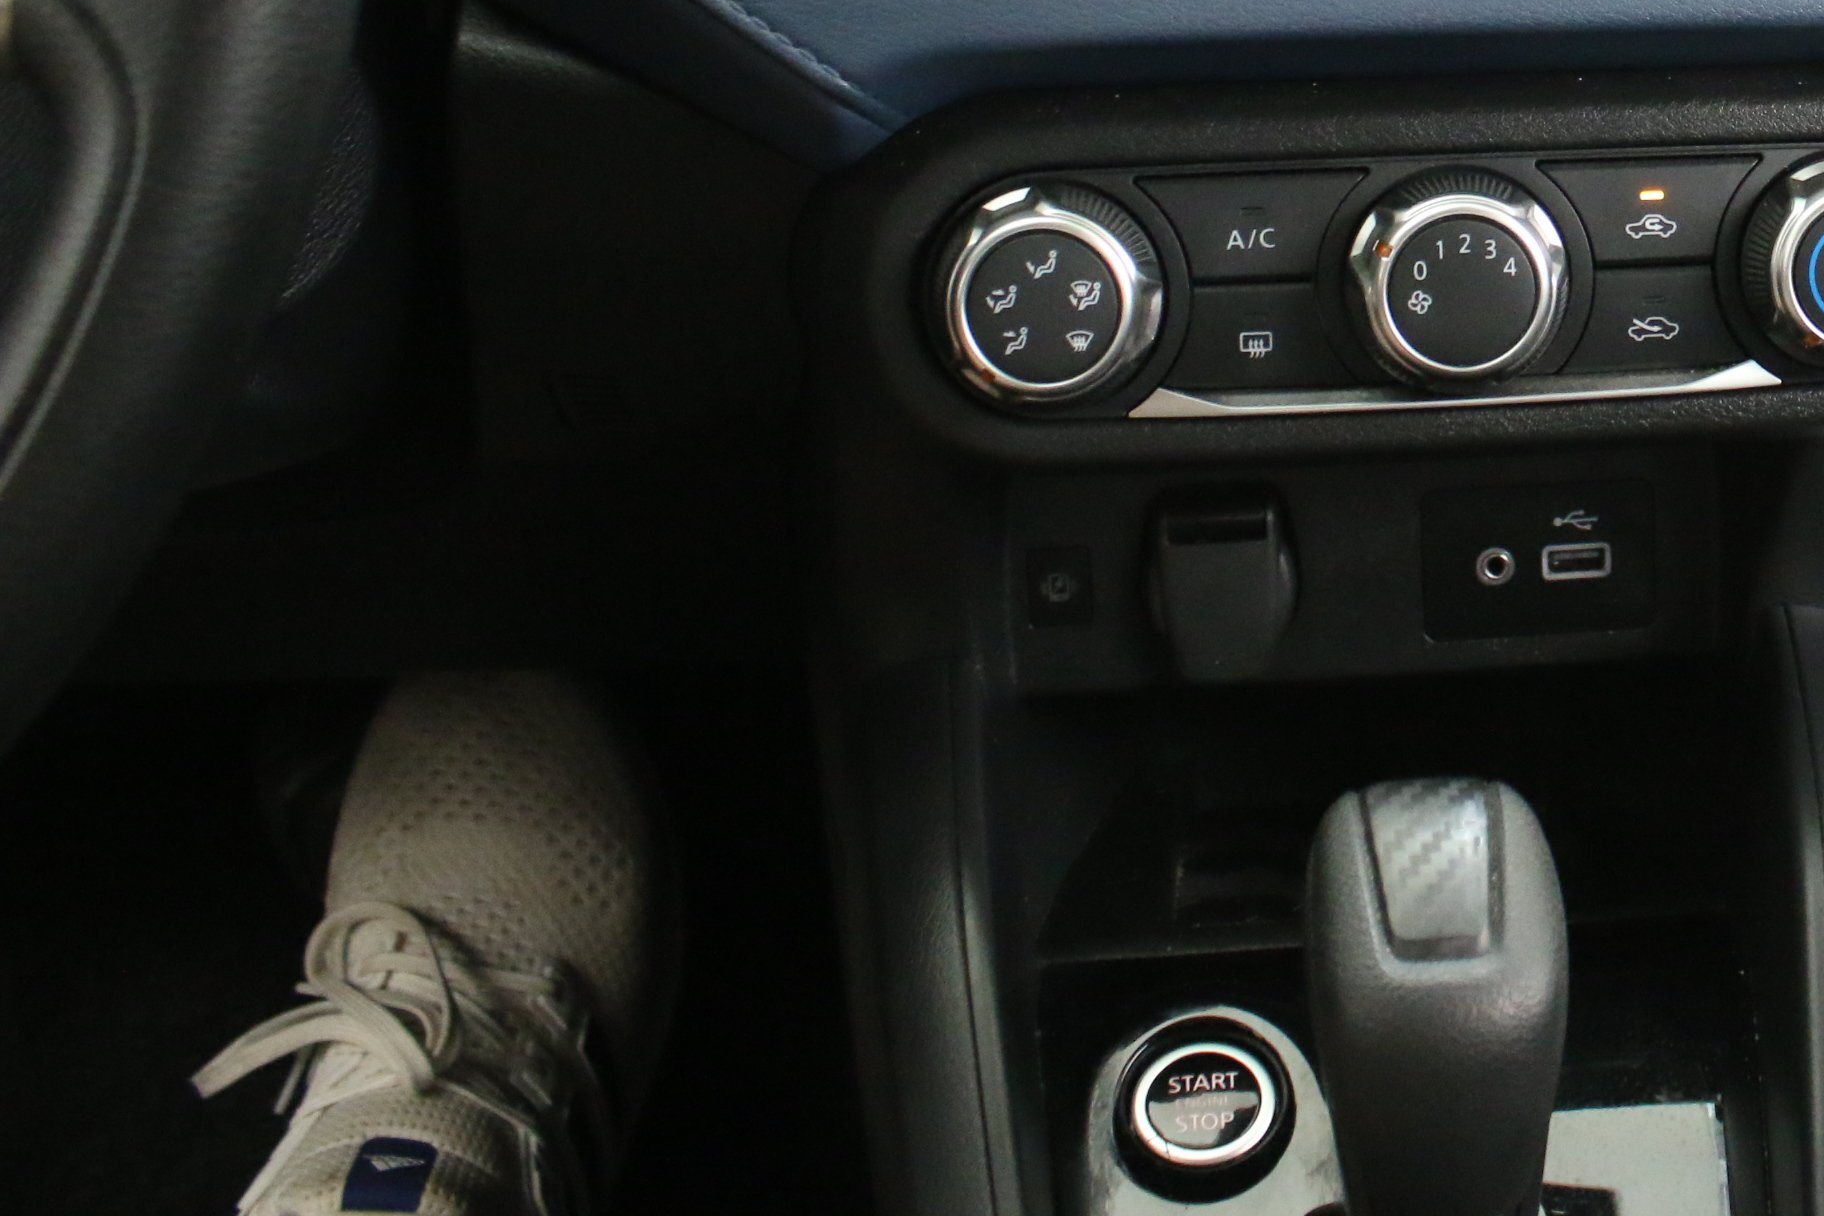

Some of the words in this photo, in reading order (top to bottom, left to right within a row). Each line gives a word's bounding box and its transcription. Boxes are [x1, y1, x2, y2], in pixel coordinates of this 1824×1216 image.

[1226, 227, 1276, 251] A/C
[1413, 260, 1428, 281] 0
[1435, 239, 1445, 261] 1
[1458, 233, 1471, 254] 2
[1484, 239, 1498, 260] 3
[1503, 257, 1518, 277] 4
[1167, 1070, 1240, 1094] START
[1174, 1110, 1234, 1134] STOP
